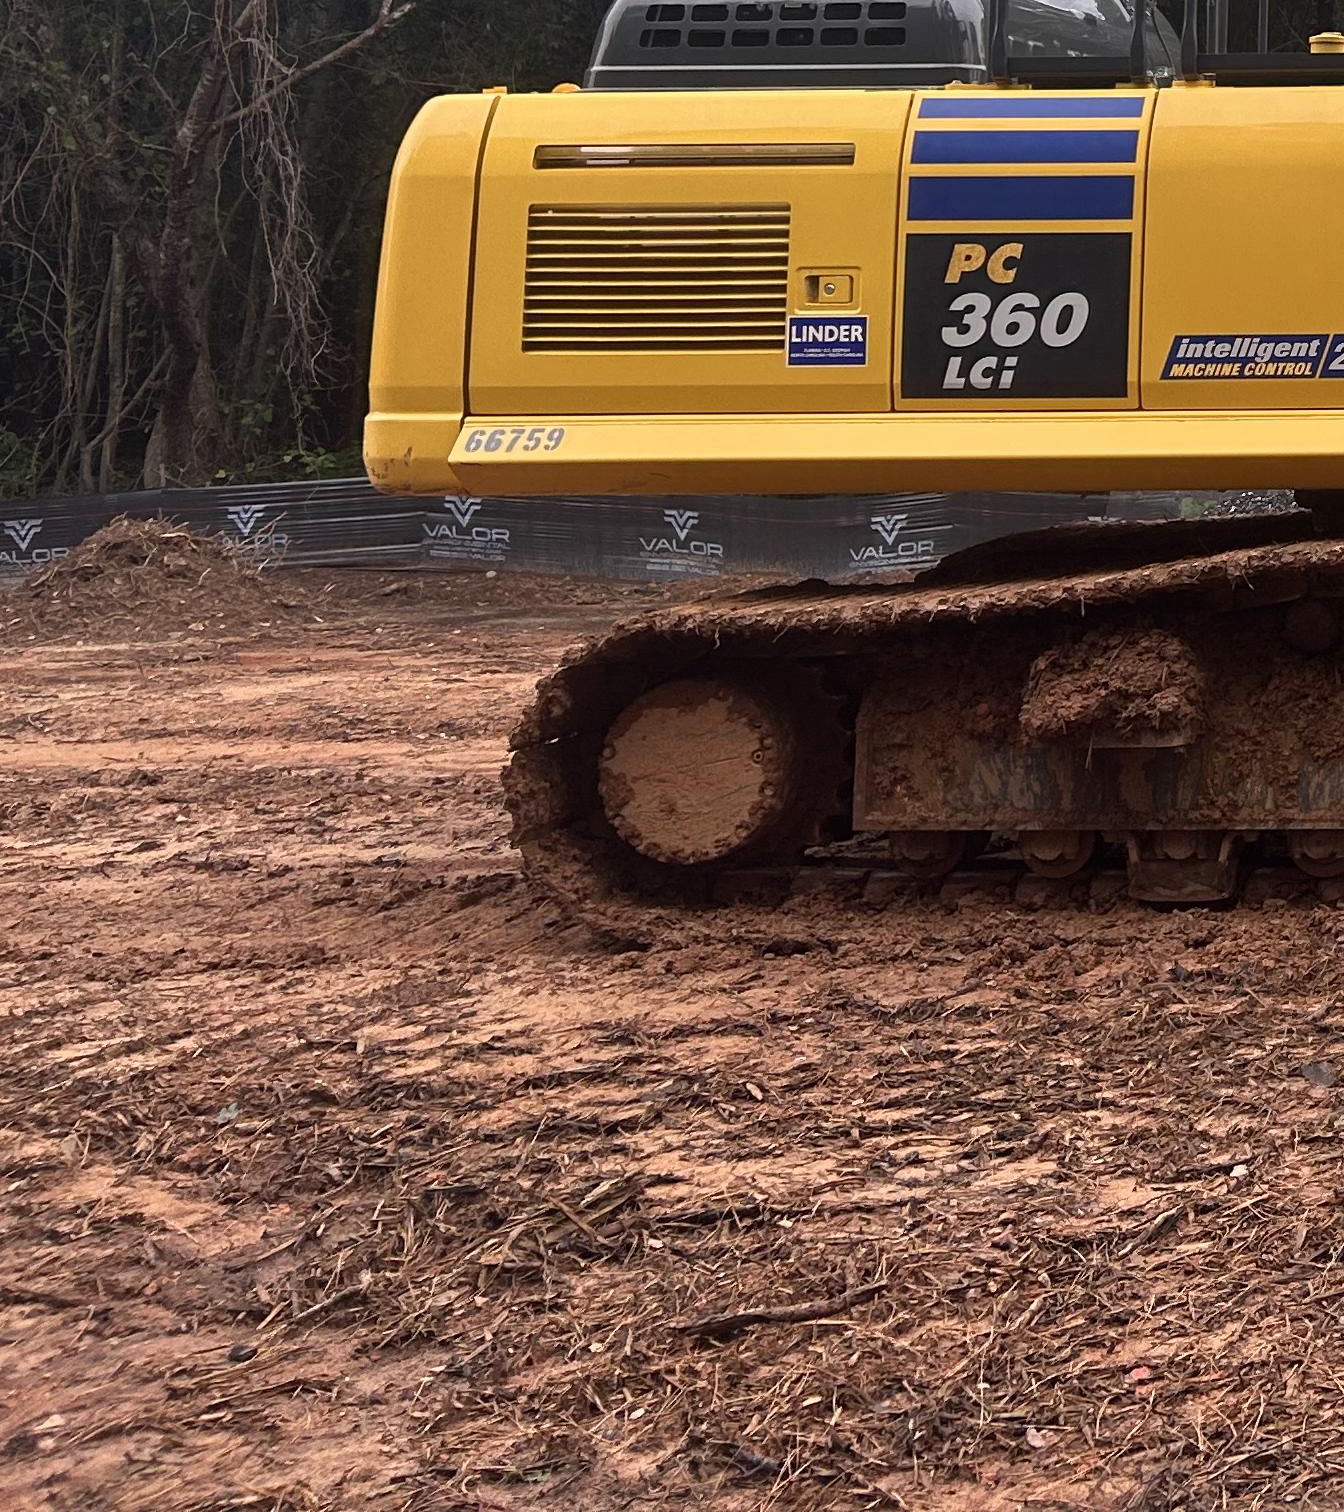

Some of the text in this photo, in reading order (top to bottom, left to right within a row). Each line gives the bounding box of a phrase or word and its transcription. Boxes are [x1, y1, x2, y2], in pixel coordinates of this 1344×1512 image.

[944, 242, 1025, 284] PC
[941, 291, 1091, 348] 360
[791, 325, 864, 343] LINDER
[1176, 338, 1321, 362] intelligent
[942, 356, 1020, 389] LCi
[1169, 362, 1313, 377] MACHINE CONTROL
[464, 427, 565, 453] 66759
[422, 523, 510, 543] VALOR
[639, 537, 724, 558] VALOR
[849, 540, 935, 561] VALOR
